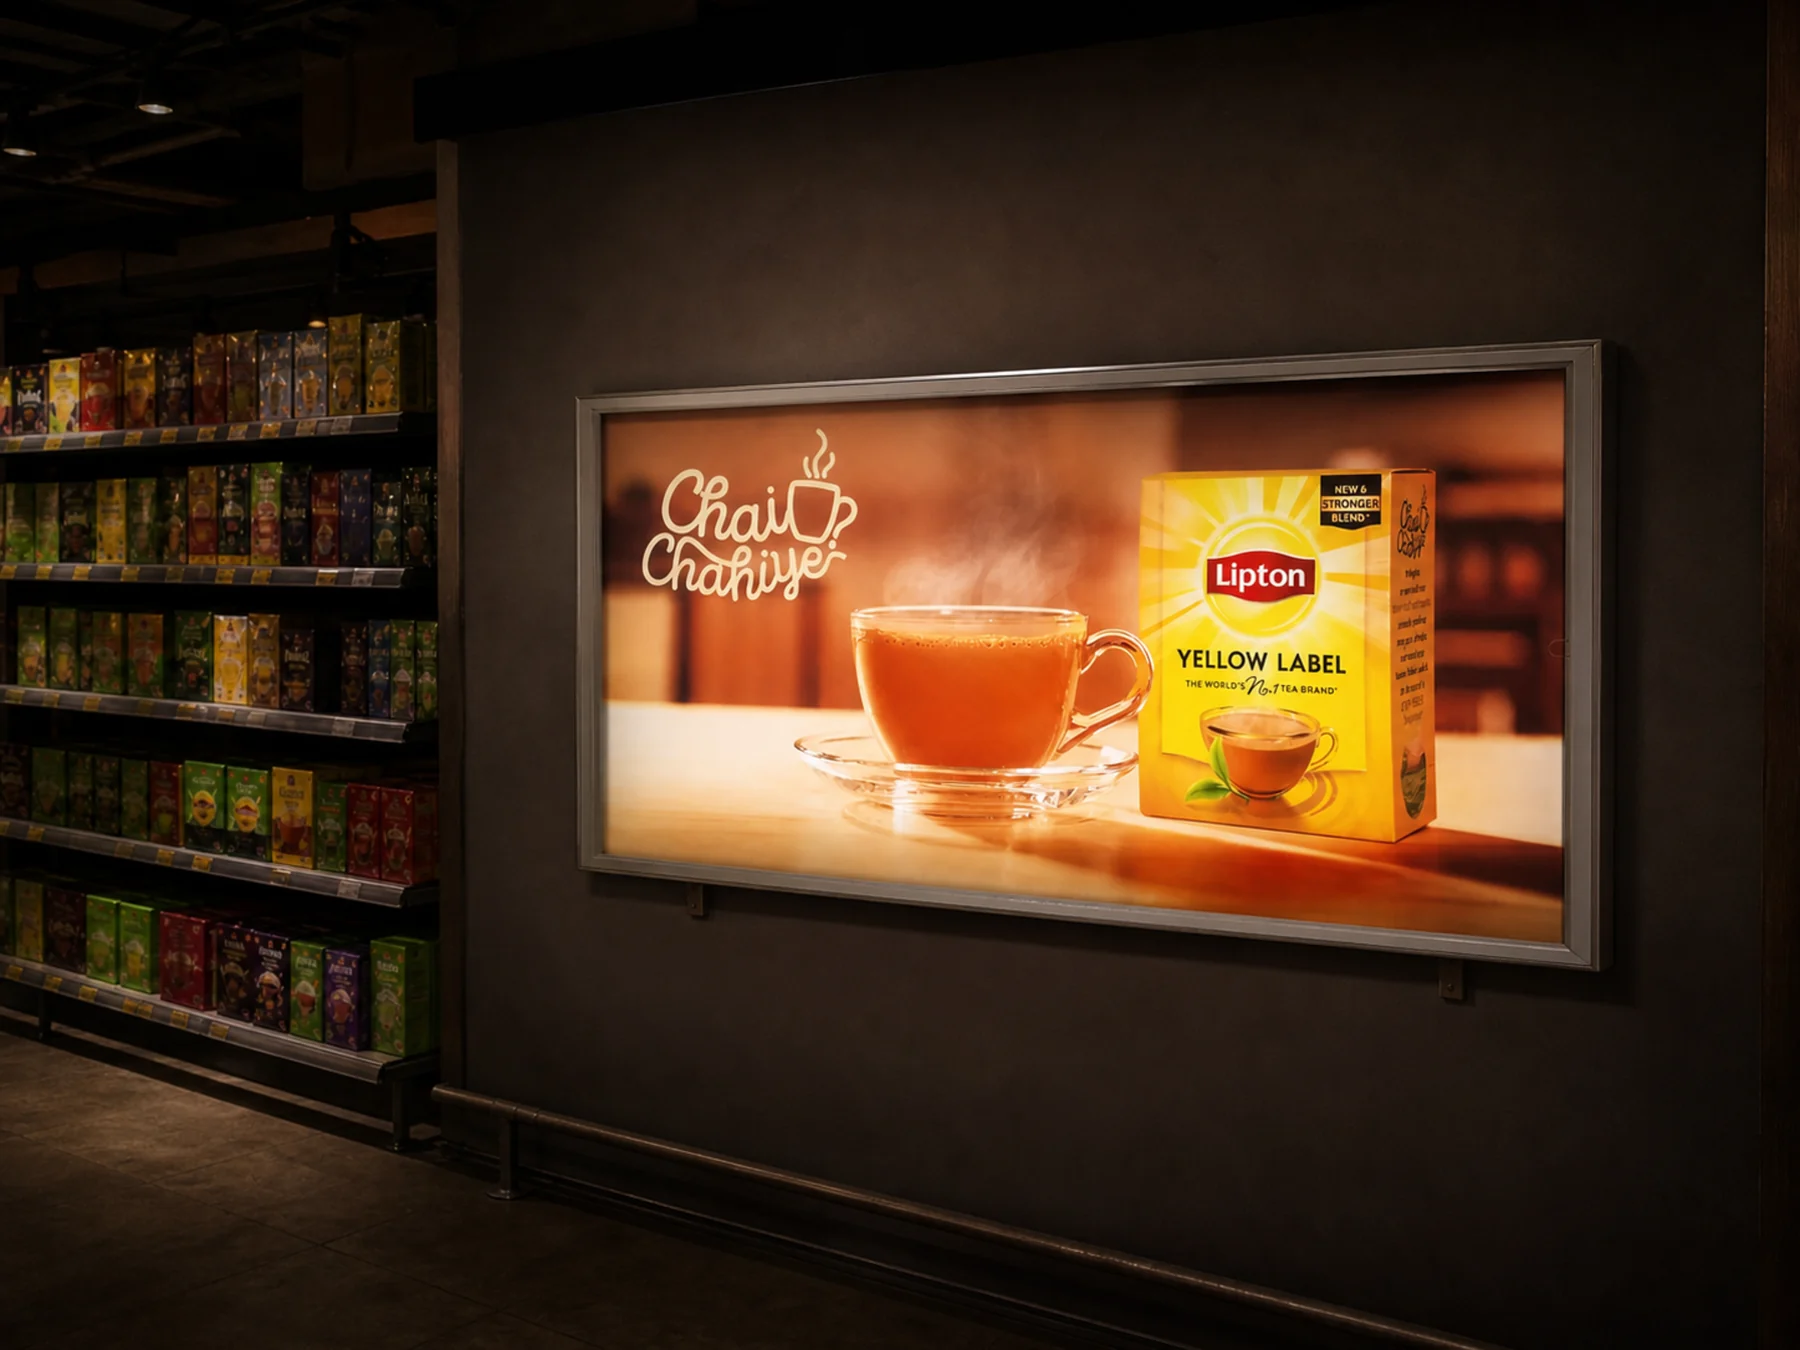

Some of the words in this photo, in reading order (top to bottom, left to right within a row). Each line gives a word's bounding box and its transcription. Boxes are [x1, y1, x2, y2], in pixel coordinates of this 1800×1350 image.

[1334, 485, 1359, 495] NEW
[1322, 498, 1379, 509] STRONGER
[642, 532, 847, 602] Chahiye
[1216, 562, 1306, 593] Lipton
[1177, 649, 1268, 671] YELLOW
[1278, 653, 1347, 674] LABEL
[1185, 679, 1202, 688] THE
[1205, 681, 1246, 690] WORLD'S
[1281, 685, 1298, 693] TEA
